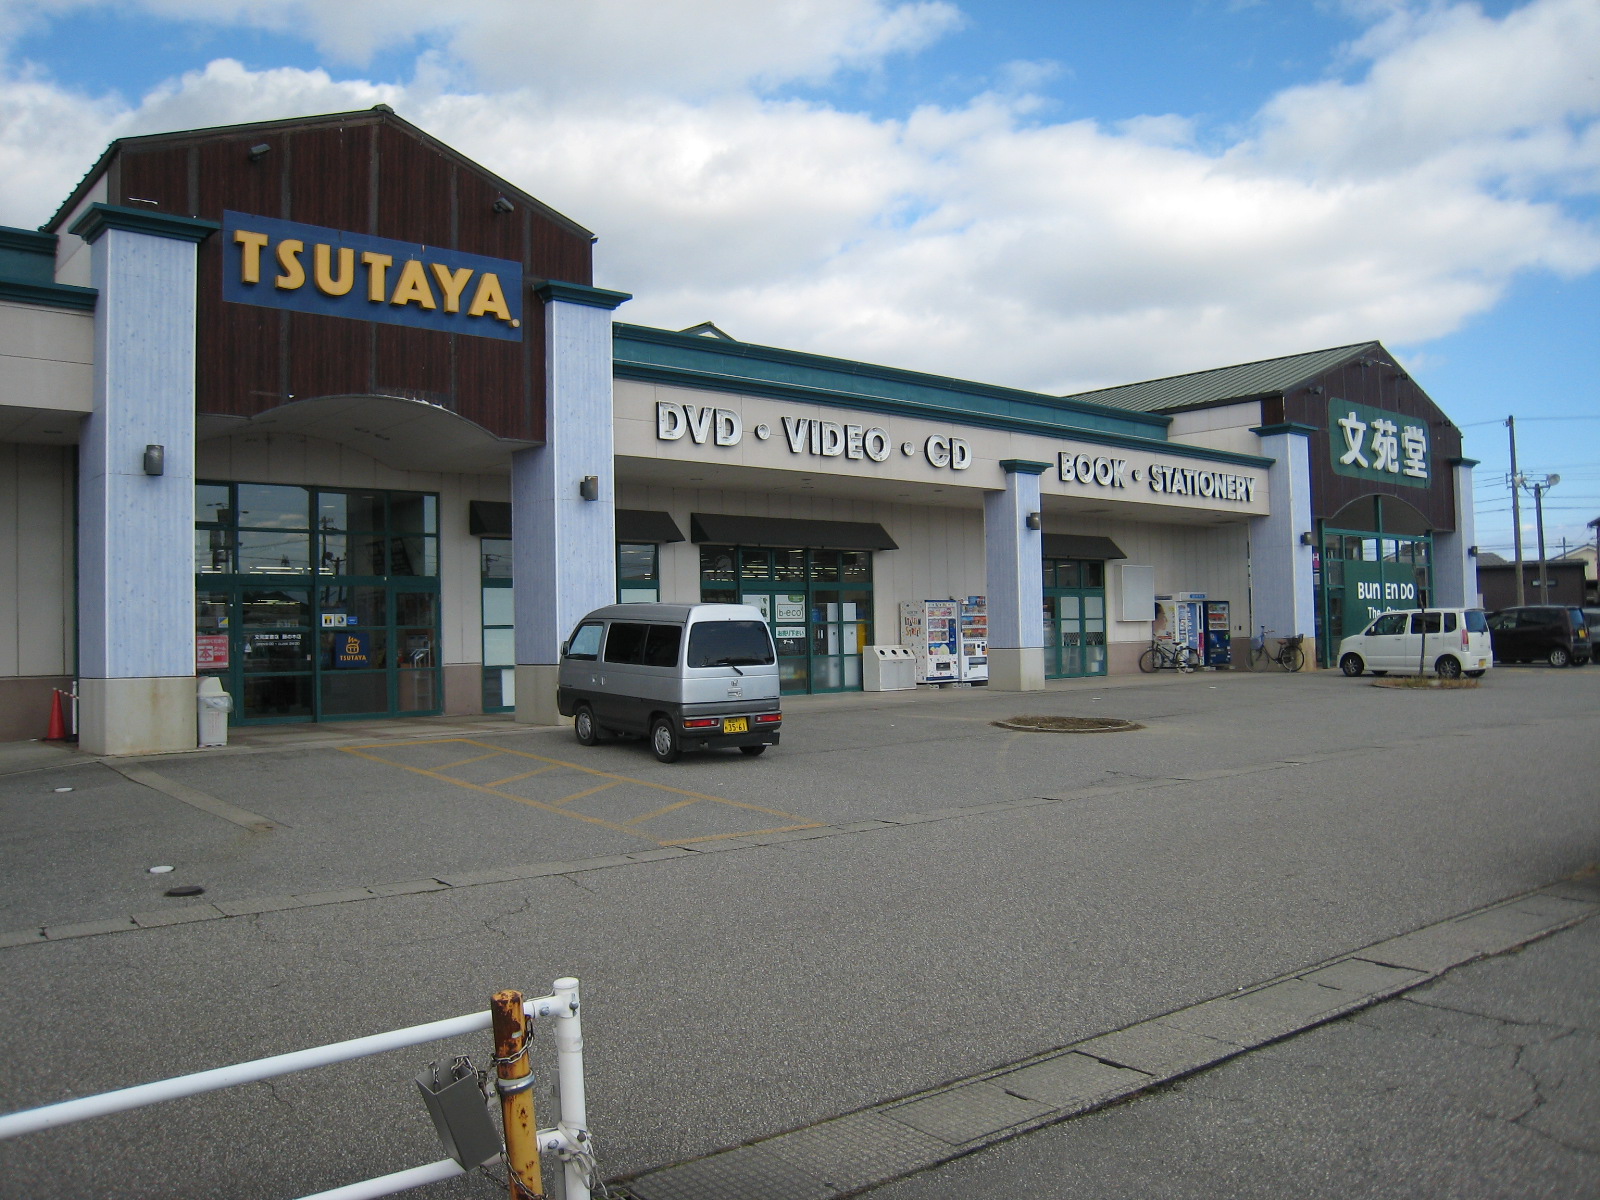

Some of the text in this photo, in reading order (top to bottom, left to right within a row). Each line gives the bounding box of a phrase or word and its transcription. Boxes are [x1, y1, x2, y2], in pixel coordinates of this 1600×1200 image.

[656, 400, 972, 470] DVD VIDEO CD
[1338, 411, 1428, 479] 文苑堂
[1058, 451, 1256, 502] BOOK STATIONERY
[1400, 583, 1414, 599] DO
